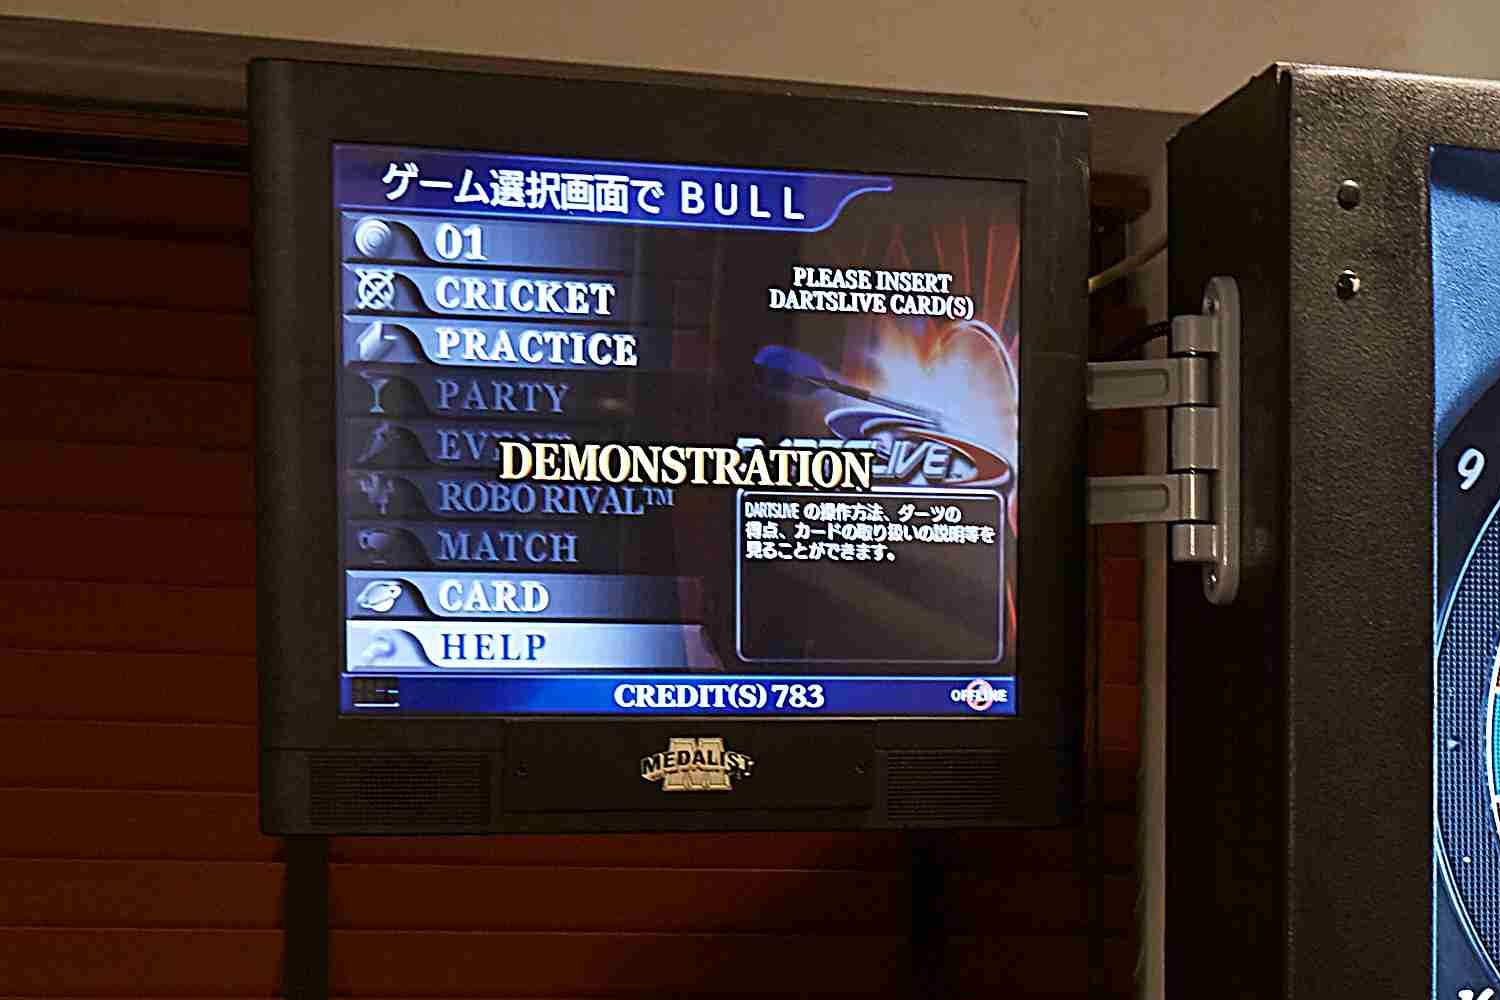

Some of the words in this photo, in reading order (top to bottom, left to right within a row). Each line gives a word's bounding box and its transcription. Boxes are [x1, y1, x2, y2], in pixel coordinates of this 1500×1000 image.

[382, 162, 665, 214] ゲーム選択画面で
[681, 180, 806, 220] BULL
[435, 222, 488, 262] 01
[435, 276, 616, 315] CRICKET
[793, 267, 872, 290] PLEASE
[876, 271, 953, 293] INSERT
[769, 289, 887, 314] DARTSLIVE
[889, 296, 975, 320] CARD(S)
[435, 327, 639, 367] PRACTICE
[435, 378, 569, 414] PARTY
[499, 441, 875, 490] DEMONSTRATION
[1456, 447, 1485, 490] 9
[438, 481, 536, 514] ROBO
[437, 529, 577, 563] MATCH
[745, 540, 896, 562] 見ることができます。
[438, 579, 550, 613] CARD
[440, 633, 547, 661] HELP
[613, 683, 768, 709] CREDIT(S)
[770, 684, 826, 709] 783
[641, 748, 755, 776] MEDALIST
